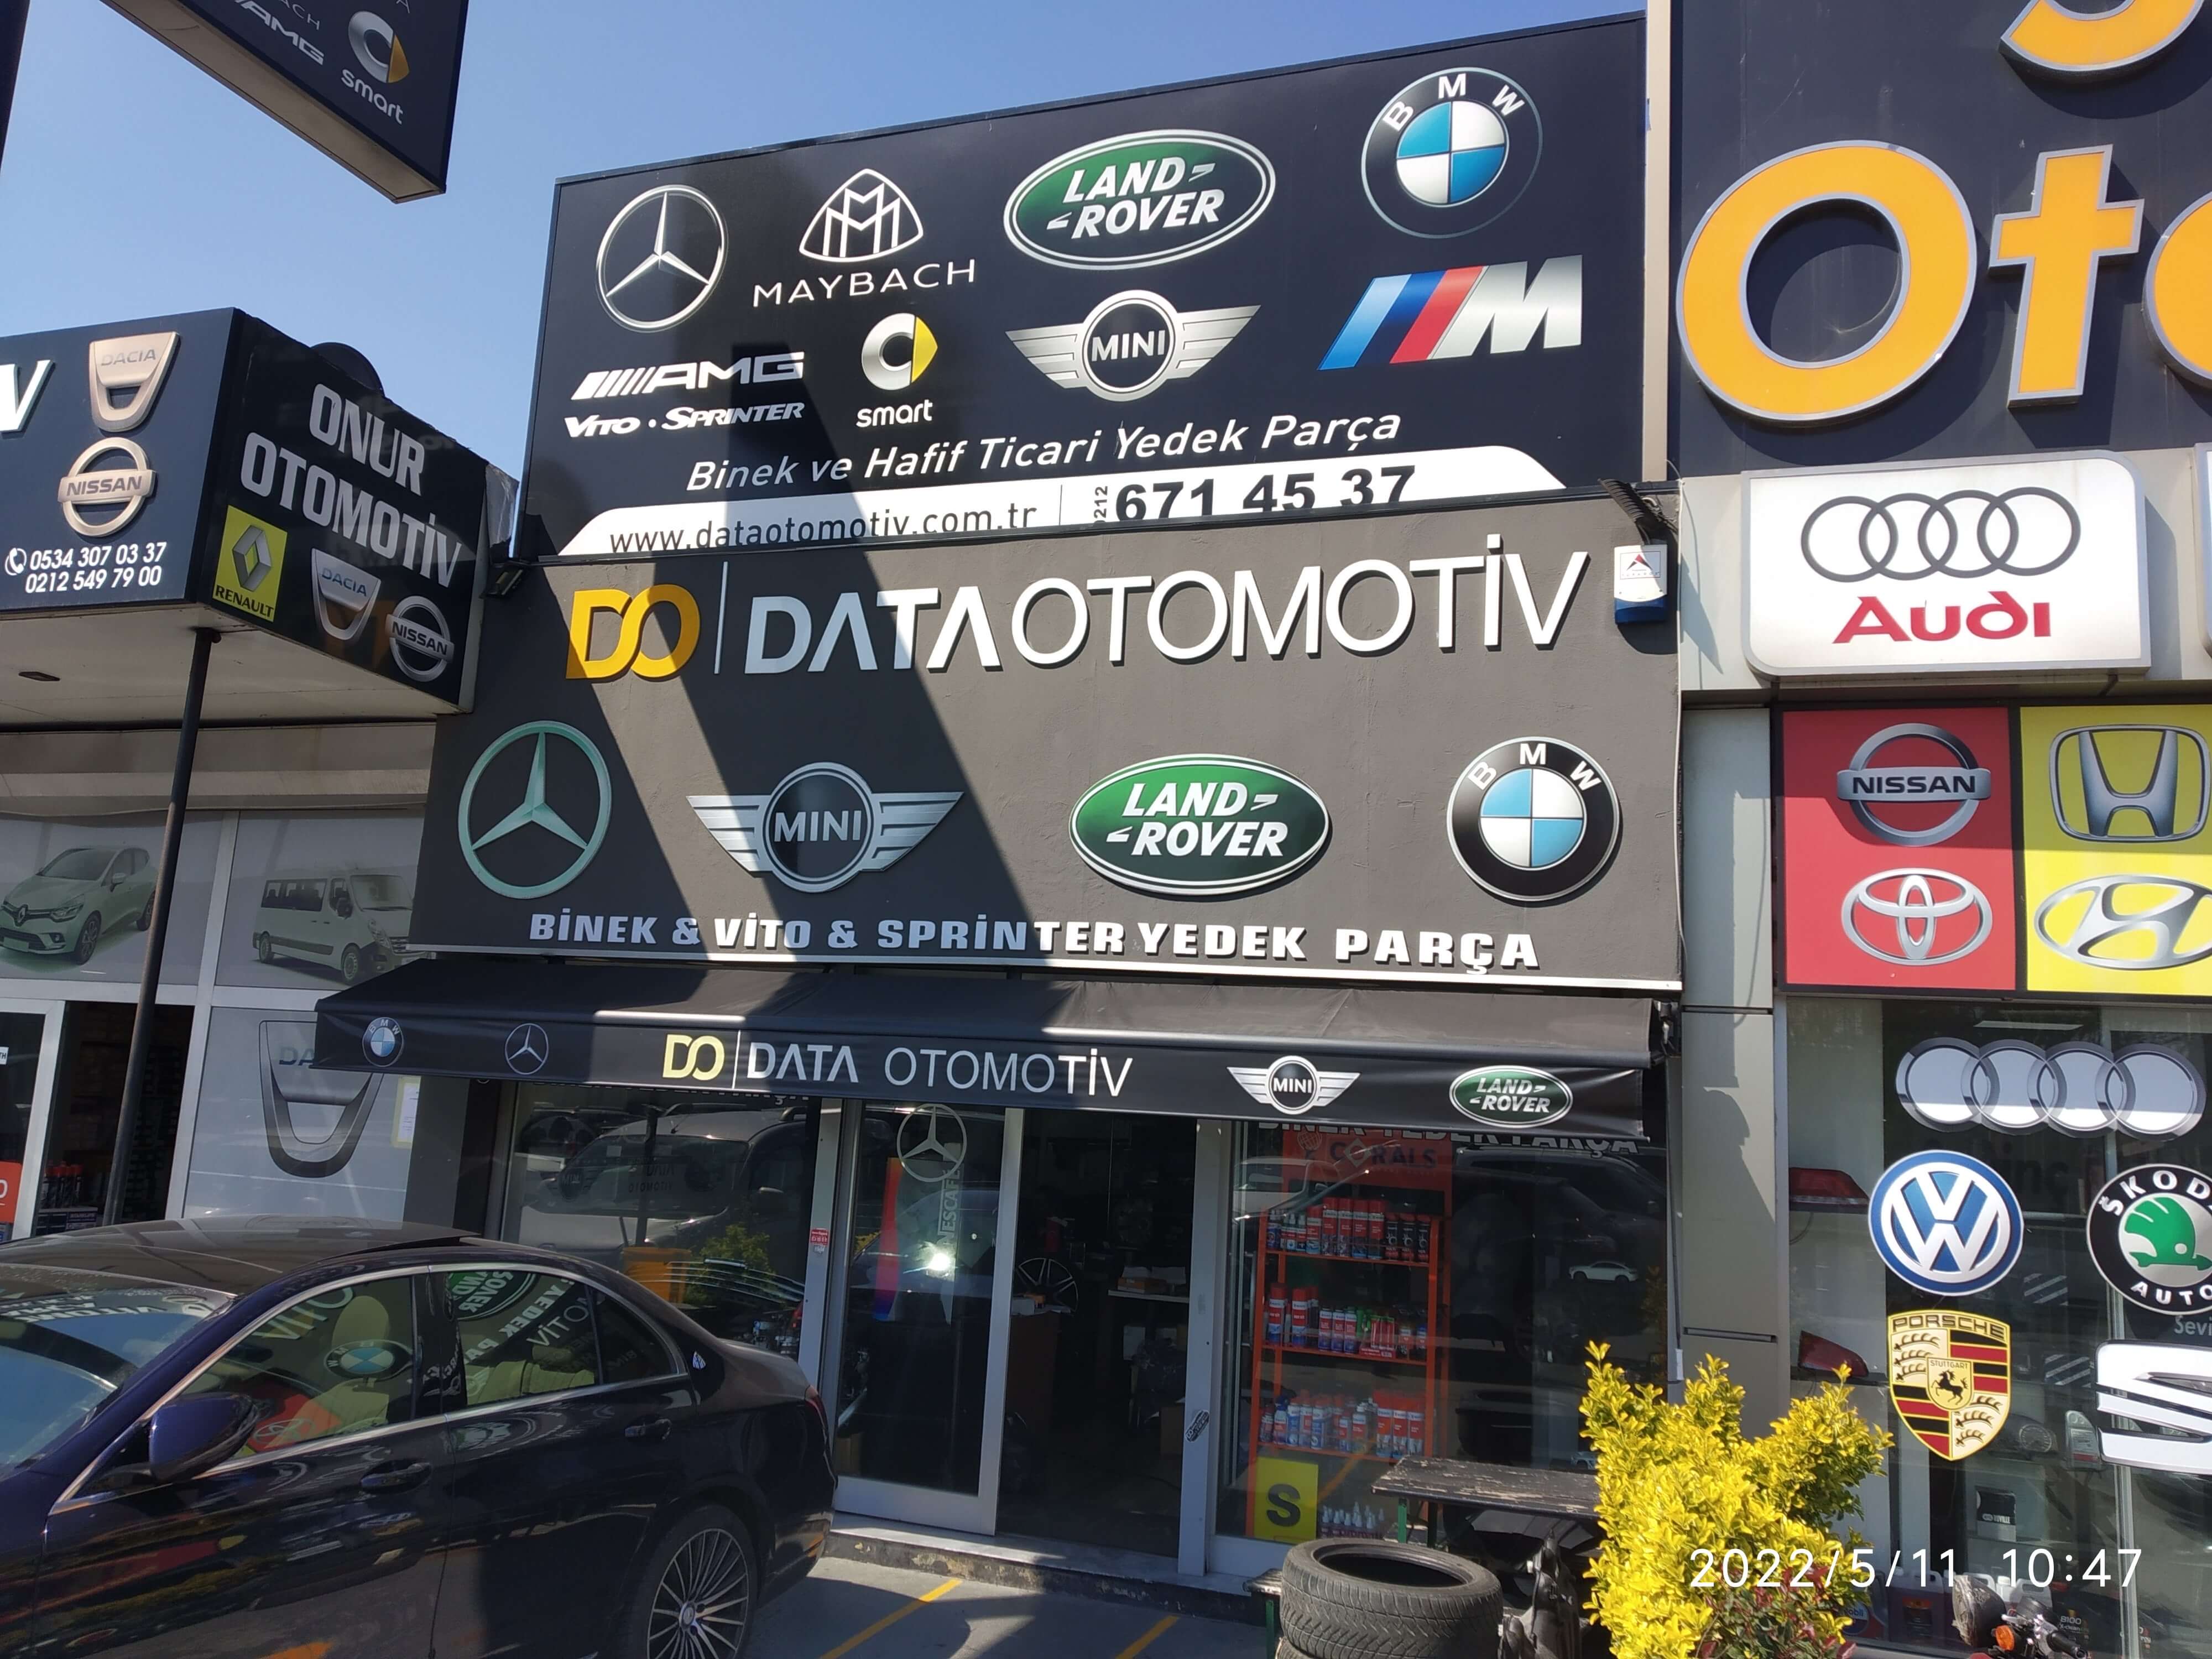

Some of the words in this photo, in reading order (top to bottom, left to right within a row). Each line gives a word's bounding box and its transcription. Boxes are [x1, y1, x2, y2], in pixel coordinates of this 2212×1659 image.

[341, 69, 404, 124] smart
[1382, 72, 1524, 131] BMW
[1063, 156, 1185, 204] LAND
[1071, 189, 1225, 239] ROVER
[752, 259, 977, 307] MAYBACH
[101, 349, 156, 367] DACIA
[1091, 330, 1166, 362] MINI
[646, 351, 804, 392] AMG
[856, 399, 933, 428] smart
[309, 384, 425, 496] ONUR
[686, 455, 801, 491] Binek
[811, 458, 852, 482] ve
[864, 441, 968, 479] Hafif
[979, 430, 1102, 469] Ticari
[1116, 419, 1245, 460] Yedek
[1262, 413, 1401, 451] Parça
[66, 476, 143, 496] NISSAN
[241, 432, 462, 588] OTOMOTİV
[611, 502, 1037, 553] www.dataotomotiv.com.tr
[1093, 486, 1108, 522] 212
[1116, 478, 1215, 521] 671
[1243, 472, 1316, 513] 45
[1339, 465, 1416, 504] 37
[29, 547, 74, 570] 0534
[78, 545, 112, 567] 307
[116, 544, 138, 565] 03
[145, 542, 167, 563] 37
[25, 572, 68, 593] 0212
[73, 570, 107, 591] 549
[111, 568, 137, 588] 79
[139, 565, 162, 586] 00
[321, 567, 368, 597] DACIA
[215, 585, 275, 619] RENAULT
[392, 620, 448, 655] NISSAN
[566, 584, 701, 680] DO
[1468, 743, 1600, 791] BMW
[1852, 775, 1976, 795] NISSAN
[1123, 781, 1246, 817] LAND
[774, 810, 862, 842] MINI
[1131, 821, 1288, 857] ROVER
[529, 907, 659, 946] BİNEK
[672, 917, 701, 946] &
[714, 912, 811, 949] VİTO
[828, 920, 858, 949] &
[877, 914, 1125, 955] SPRİNTER
[1138, 922, 1307, 961] YEDEK
[1334, 928, 1541, 975] PARÇA
[369, 1019, 400, 1035] BMW
[662, 1034, 725, 1081] DO
[747, 1042, 859, 1083] DATA
[884, 1048, 1133, 1097] OTOMOTİV
[1273, 1078, 1312, 1094] MINI
[1476, 1077, 1534, 1095] LAND
[1481, 1095, 1551, 1114] ROVER
[2098, 1170, 2212, 1215] ŠKOD
[1892, 1314, 2005, 1342] PORSCHE
[1930, 1360, 1968, 1369] STUTTGART
[1266, 1484, 1301, 1527] S
